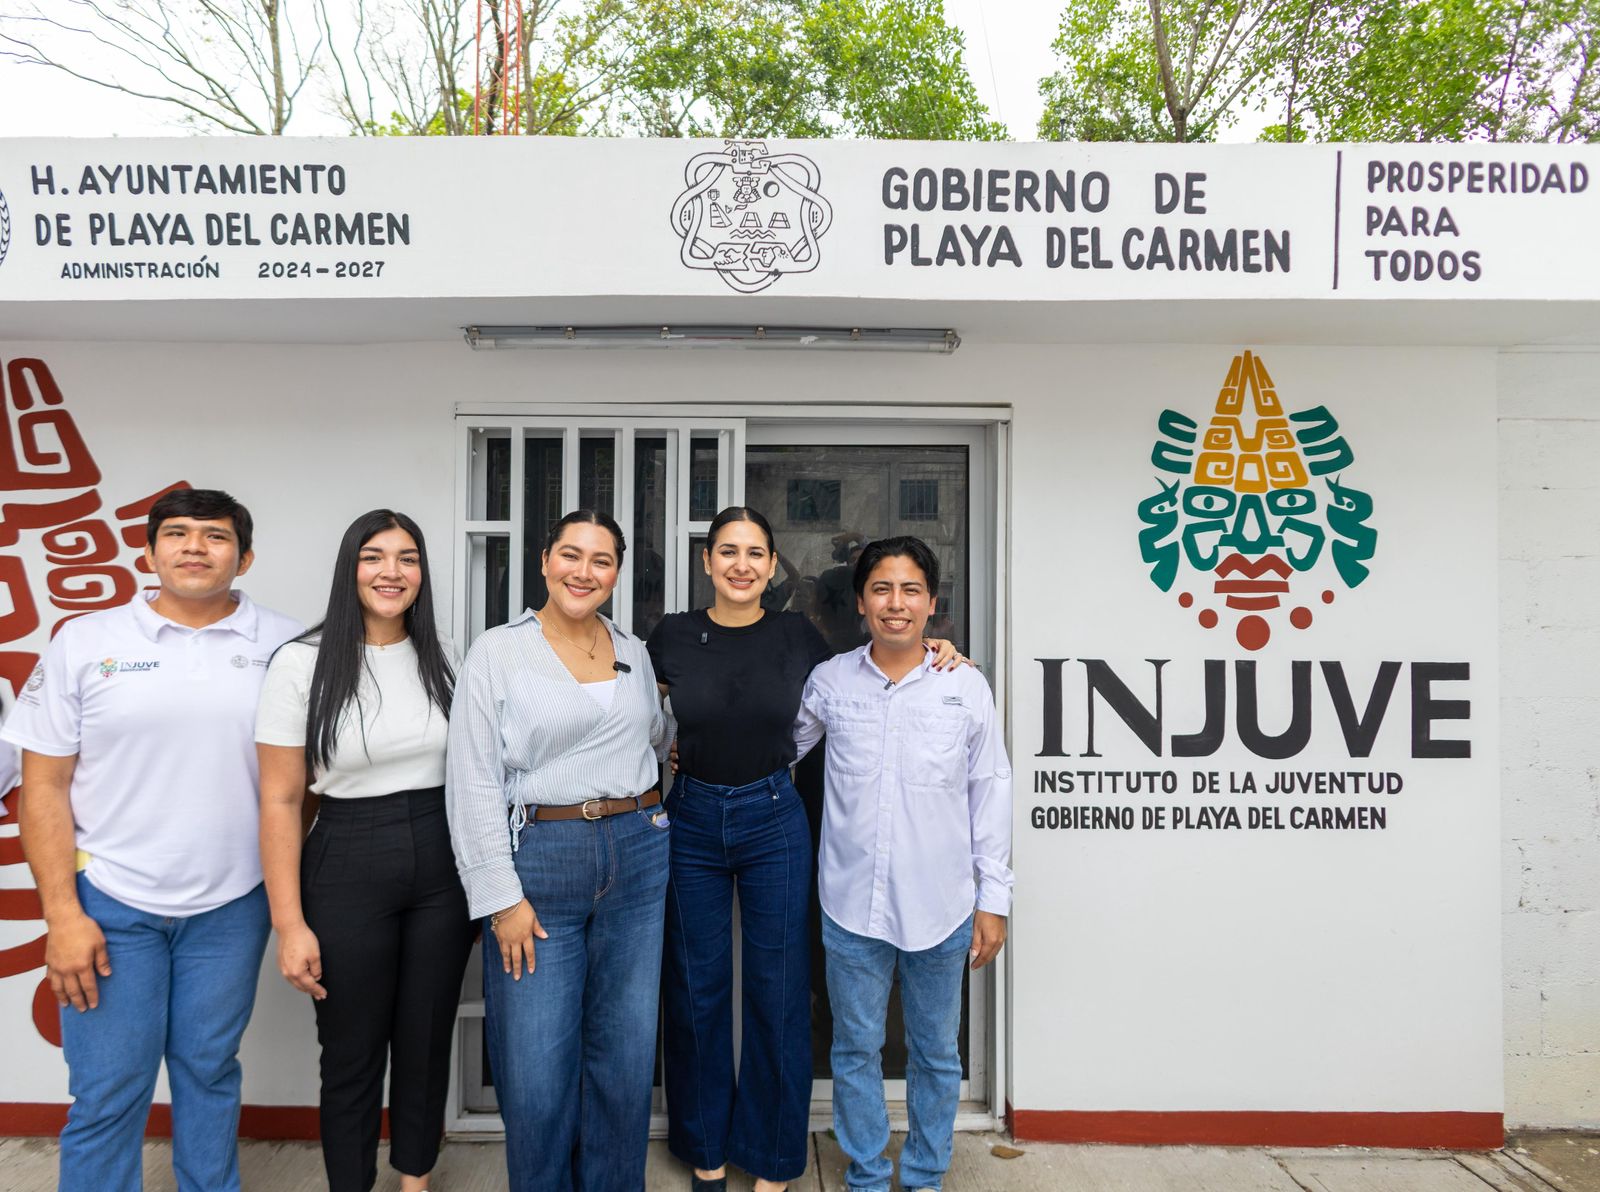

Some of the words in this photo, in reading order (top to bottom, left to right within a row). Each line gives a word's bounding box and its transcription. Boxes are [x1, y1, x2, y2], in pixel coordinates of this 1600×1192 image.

[31, 165, 68, 195] H.
[79, 164, 345, 195] AYUNTAMIENTO
[882, 167, 1109, 213] GOBIERNO
[1155, 173, 1206, 214] DE
[1368, 161, 1588, 193] PROSPERIDAD
[35, 214, 71, 246] DE
[89, 213, 194, 246] PLAYA
[206, 213, 261, 245] DEL
[271, 213, 409, 245] CARMEN
[1367, 206, 1459, 236] PARA
[884, 224, 1022, 267] PLAYA
[1047, 227, 1113, 269] DEL
[1122, 227, 1290, 273] CARMEN
[61, 255, 219, 279] ADMINISTRACIÓN
[1365, 250, 1480, 281] TODOS
[119, 661, 161, 669] INJUVE
[1034, 658, 1471, 759] INJUVE
[1034, 771, 1177, 794] INSTITUTO
[1193, 772, 1220, 793] DE
[1230, 772, 1257, 793] LA
[1266, 772, 1403, 794] JUVENTUD
[1031, 807, 1134, 830] GOBIERNO
[1143, 807, 1165, 829] DE
[1173, 807, 1242, 829] PLAYA
[1248, 807, 1285, 829] DEL
[1290, 806, 1386, 829] CARMEN
